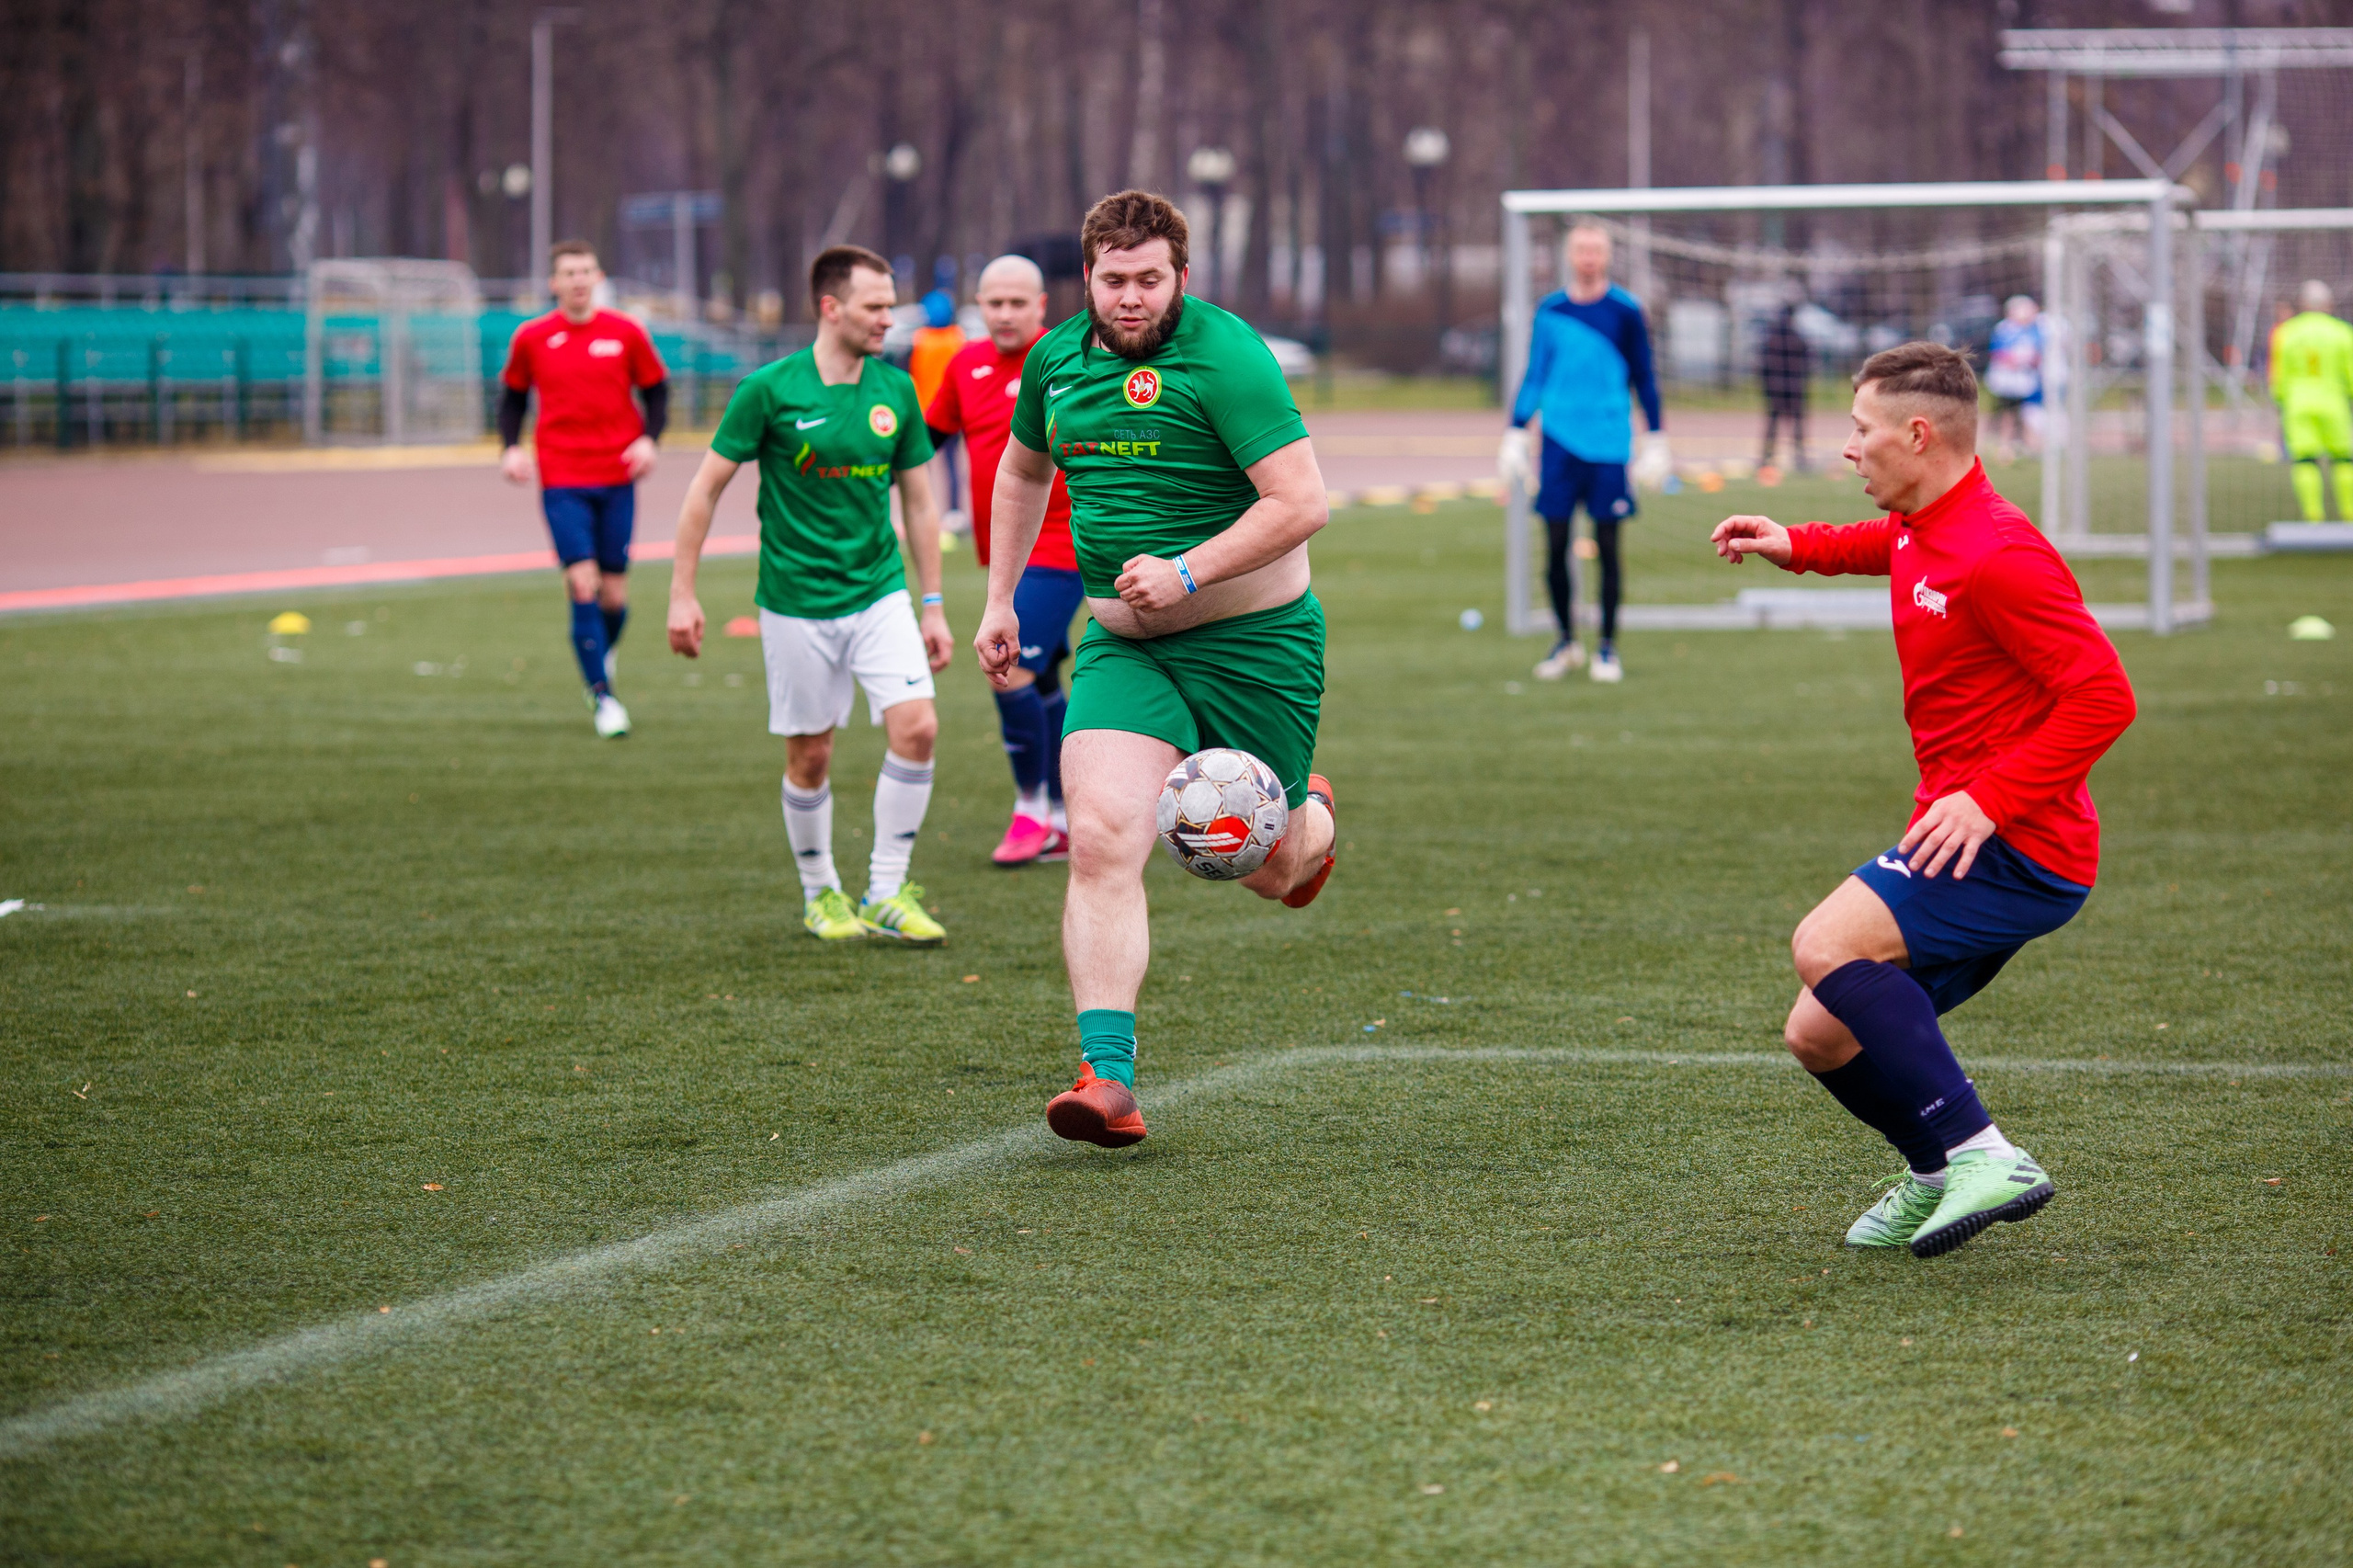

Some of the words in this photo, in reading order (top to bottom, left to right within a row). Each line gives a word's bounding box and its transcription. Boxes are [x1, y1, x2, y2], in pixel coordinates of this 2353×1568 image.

[1113, 429, 1137, 439] СЕТЬ
[1139, 428, 1161, 439] АЗС
[1058, 440, 1162, 458] TATNEFT
[816, 463, 891, 479] TATNEF
